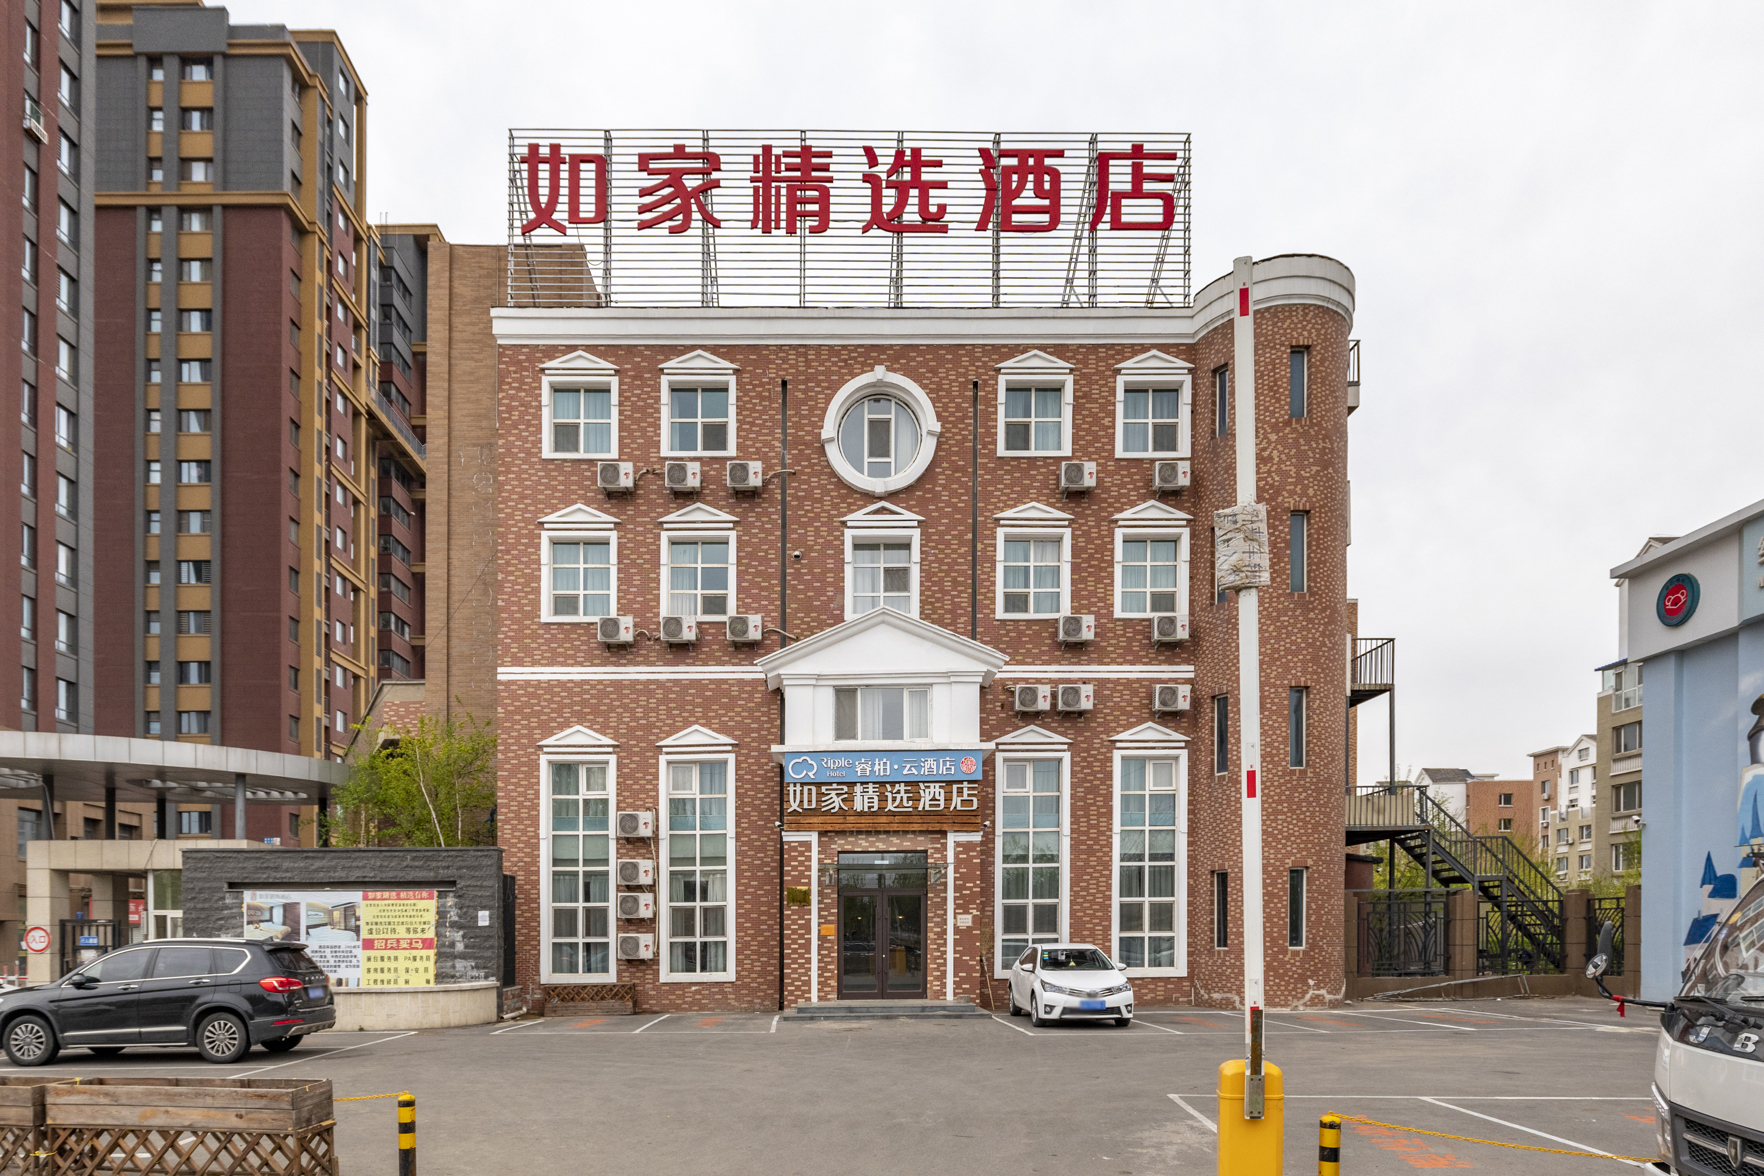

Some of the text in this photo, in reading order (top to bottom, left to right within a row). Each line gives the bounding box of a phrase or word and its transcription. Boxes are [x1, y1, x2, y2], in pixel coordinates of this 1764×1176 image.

[520, 142, 1178, 235] 如家精选酒店
[820, 757, 853, 771] Ripple
[854, 757, 956, 777] 睿柏·云酒店
[826, 770, 846, 778] Hotel
[786, 781, 979, 813] 如家精选酒店
[30, 934, 47, 945] 入口
[373, 939, 423, 949] 招兵买马
